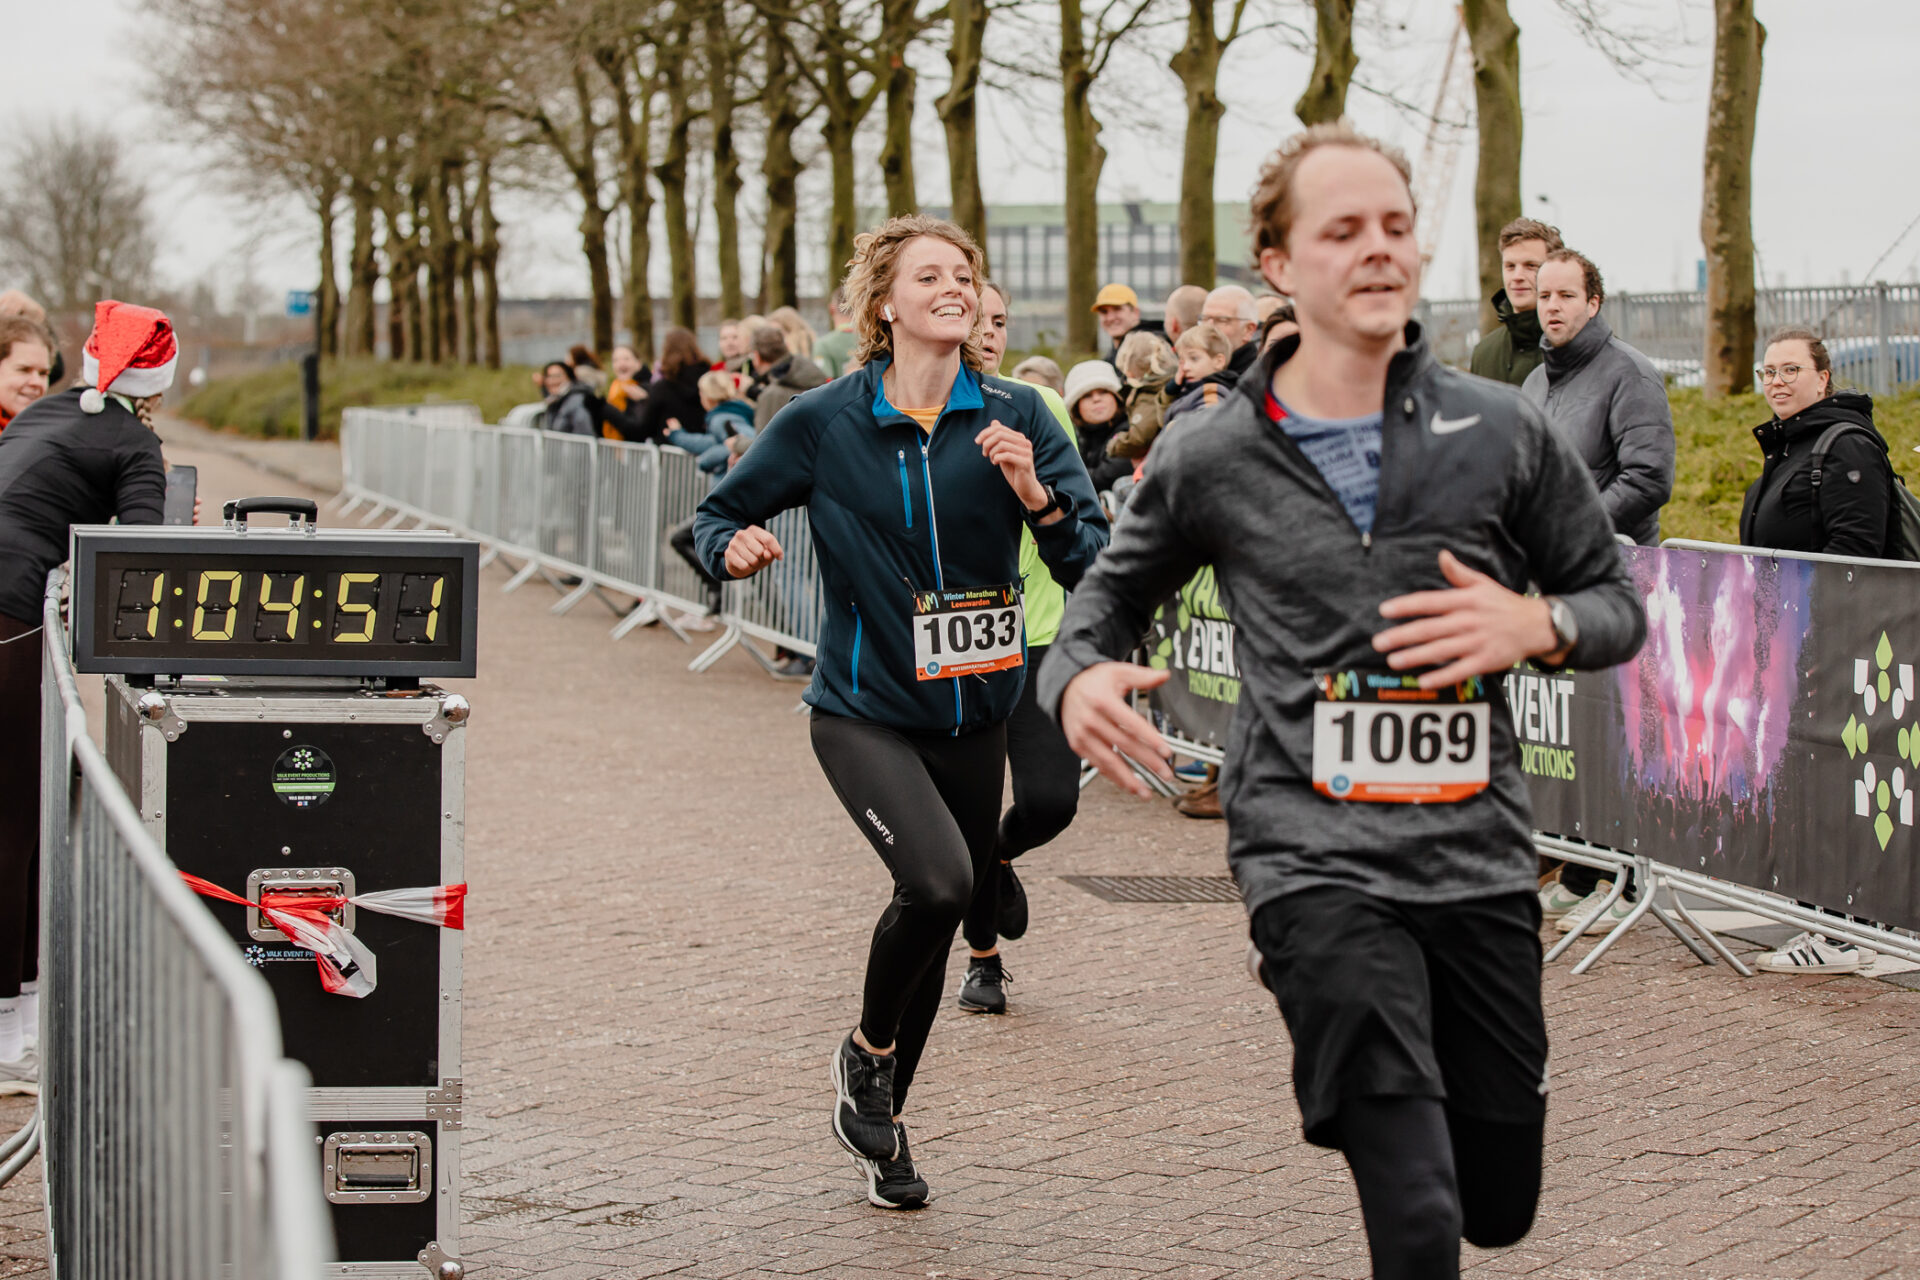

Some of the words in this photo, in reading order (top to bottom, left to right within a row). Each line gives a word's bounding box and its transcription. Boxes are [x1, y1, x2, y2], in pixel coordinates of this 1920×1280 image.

[146, 570, 444, 643] 1:04:51
[943, 592, 966, 601] Winter
[966, 589, 998, 599] Marathon
[1181, 563, 1231, 621] VAL
[923, 610, 1016, 655] 1033
[1187, 617, 1241, 678] EVEN
[1188, 669, 1242, 705] PRODUCTION
[1503, 673, 1575, 746] VENT
[1332, 711, 1476, 764] 1069
[866, 808, 890, 837] CRAFT
